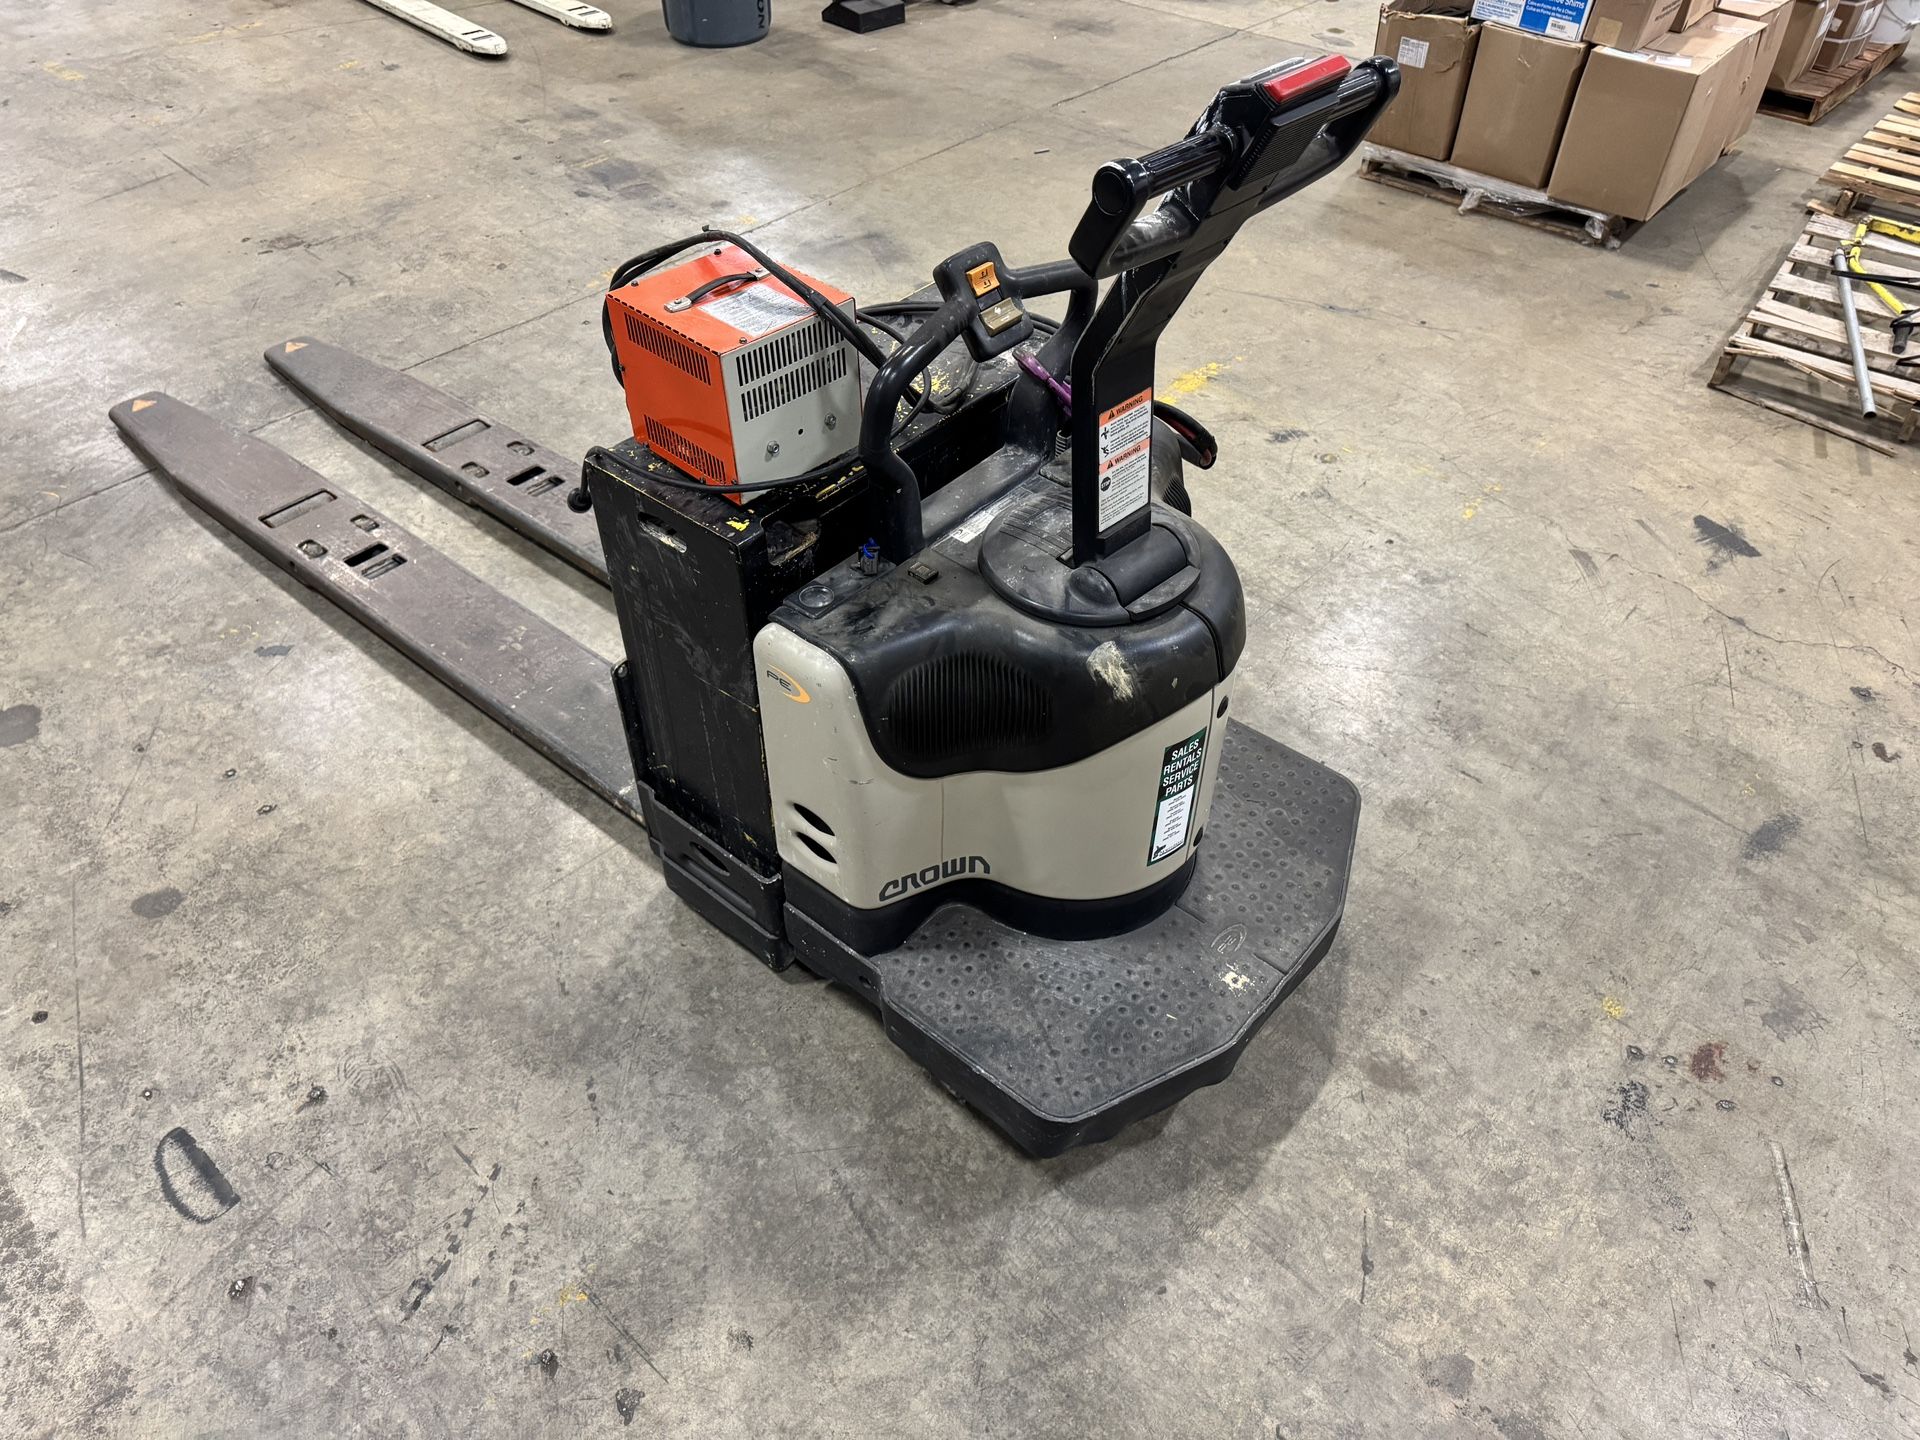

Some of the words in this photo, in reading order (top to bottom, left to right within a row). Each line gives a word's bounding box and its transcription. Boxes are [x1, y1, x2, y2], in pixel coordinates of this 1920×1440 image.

[1116, 395, 1143, 415] WARNING
[1114, 444, 1141, 465] WARNING
[766, 670, 792, 692] PE
[1171, 738, 1200, 761] SALES
[1163, 747, 1202, 776] RENTALS
[1162, 760, 1200, 787] SERVICE
[1165, 775, 1193, 797] PARTS
[879, 856, 991, 902] CROWN
